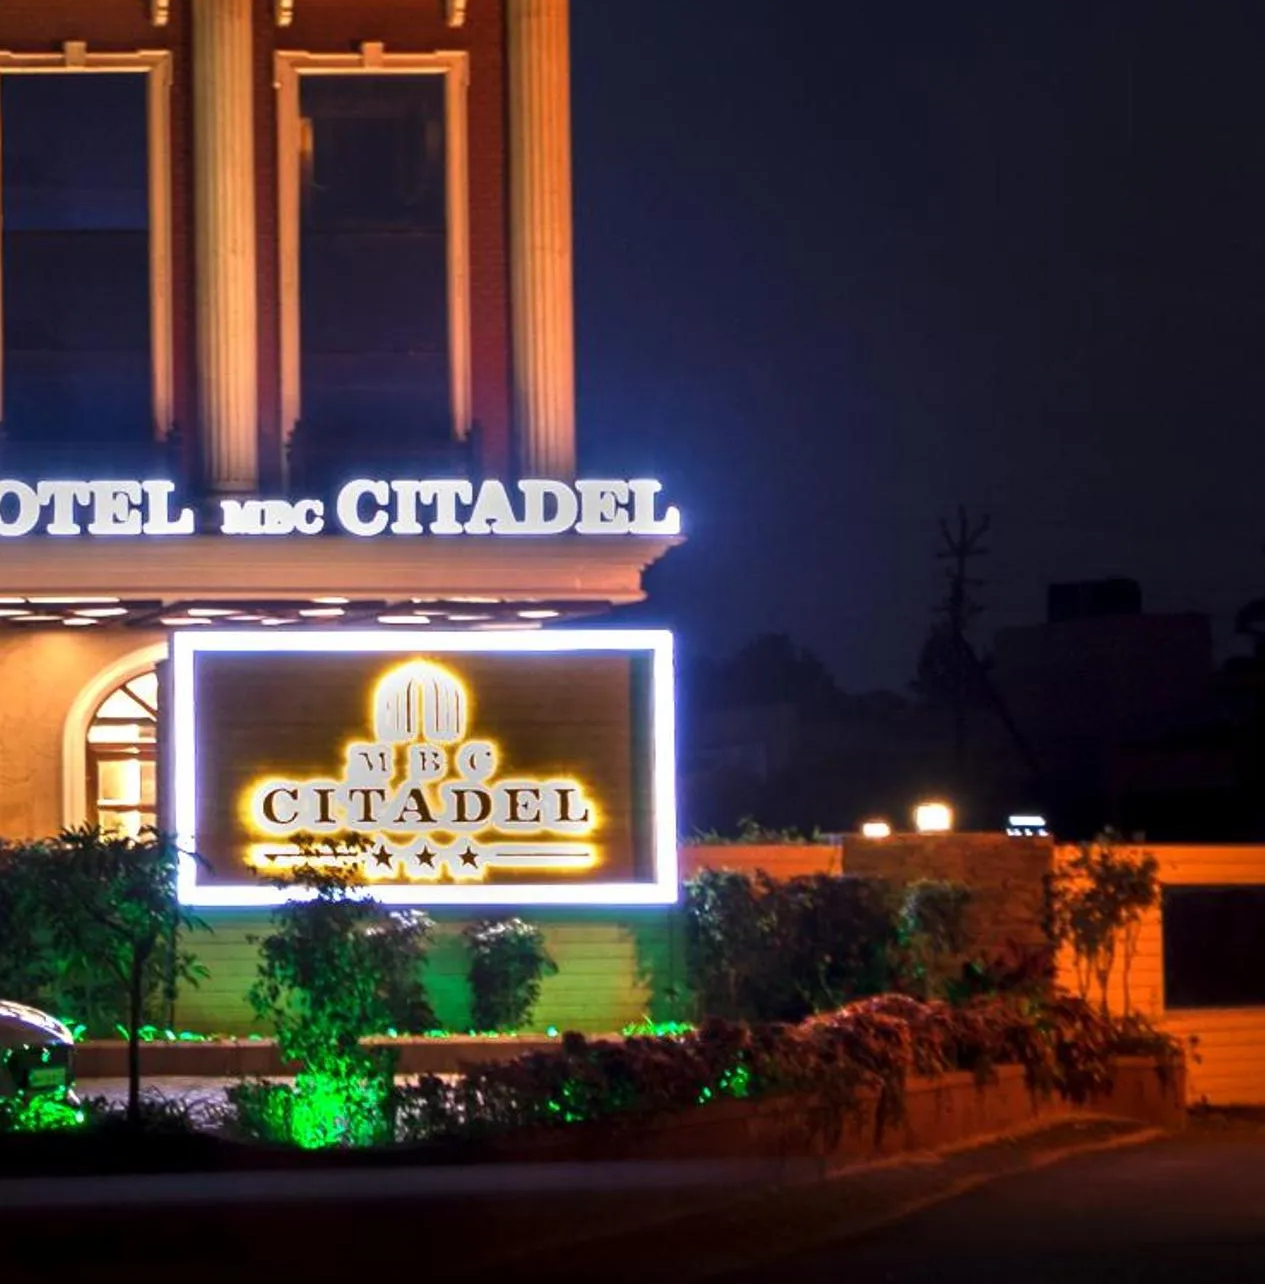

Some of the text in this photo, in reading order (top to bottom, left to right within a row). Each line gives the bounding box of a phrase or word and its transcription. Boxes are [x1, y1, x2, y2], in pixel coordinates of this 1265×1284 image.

[219, 499, 324, 535] MBC
[336, 478, 681, 537] CITADEL
[262, 787, 590, 825] CITADEL
